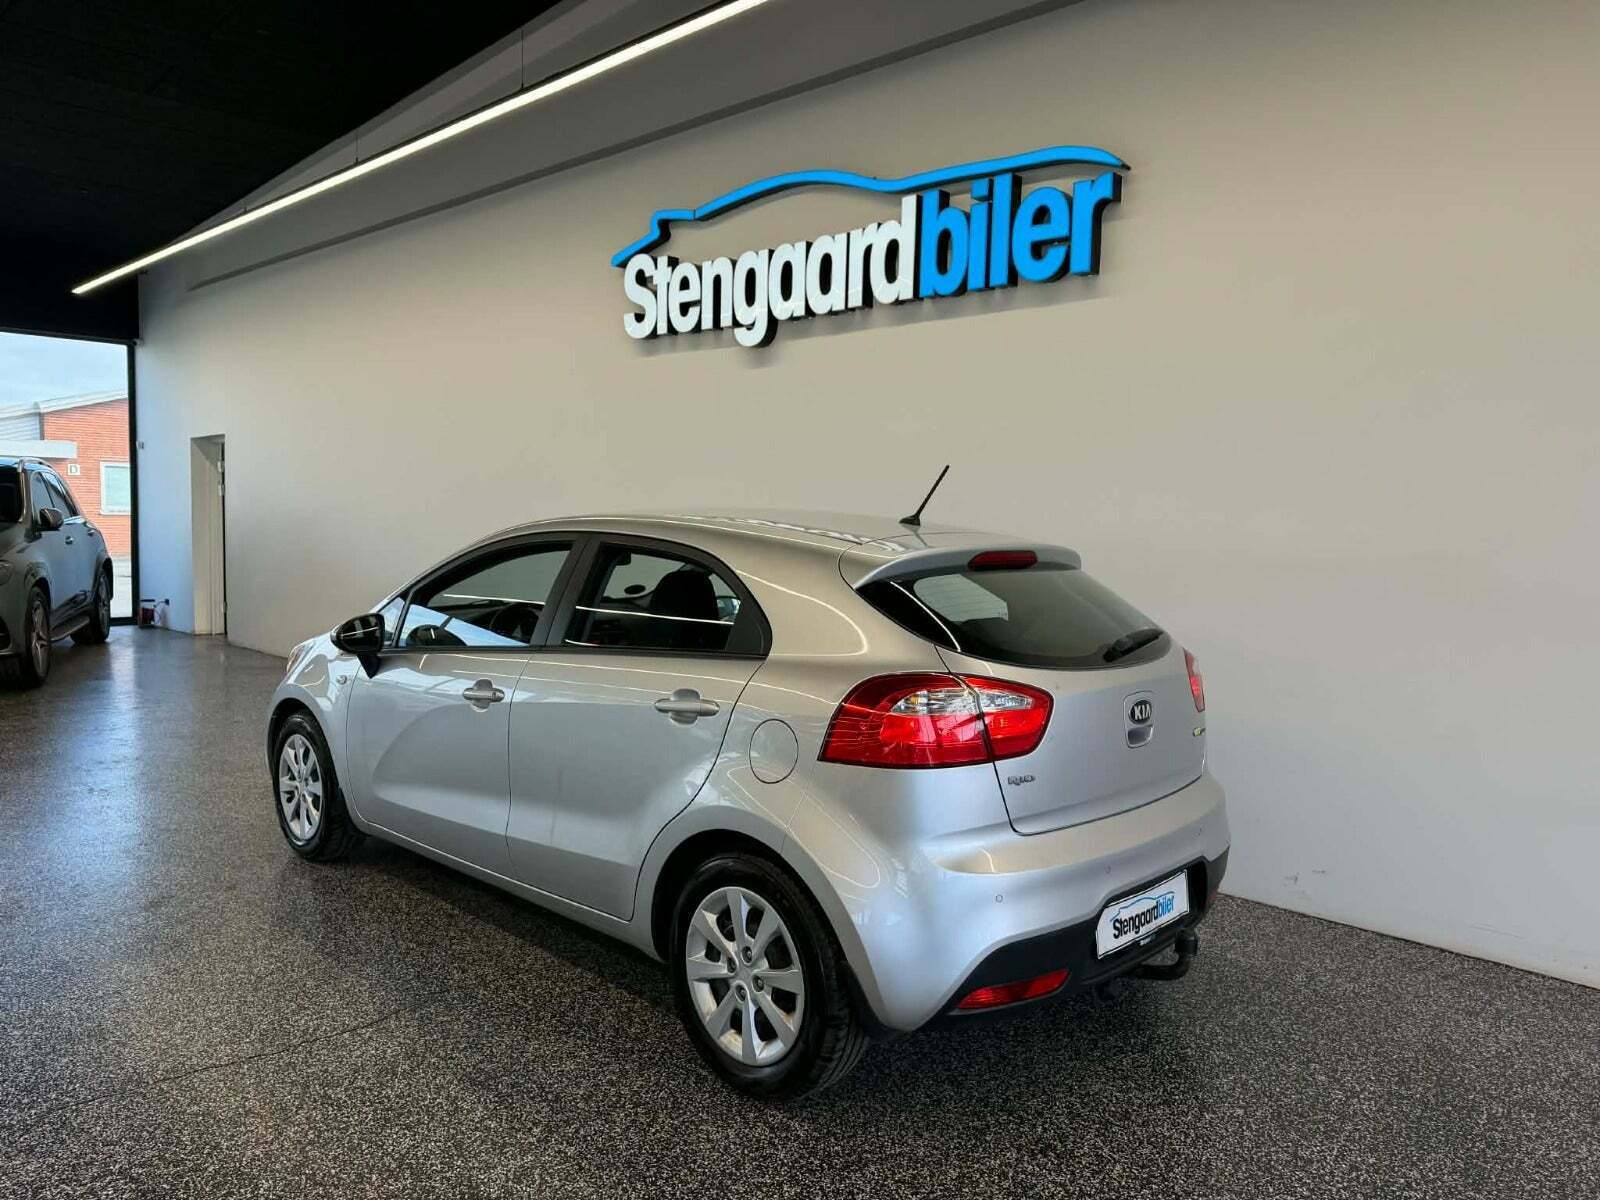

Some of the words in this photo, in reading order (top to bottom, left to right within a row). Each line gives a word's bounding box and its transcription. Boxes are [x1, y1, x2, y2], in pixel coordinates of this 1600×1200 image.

[623, 172, 1121, 347] Stengaardbiler
[1134, 703, 1151, 720] KIA
[1112, 895, 1174, 939] Stengaardbiler
